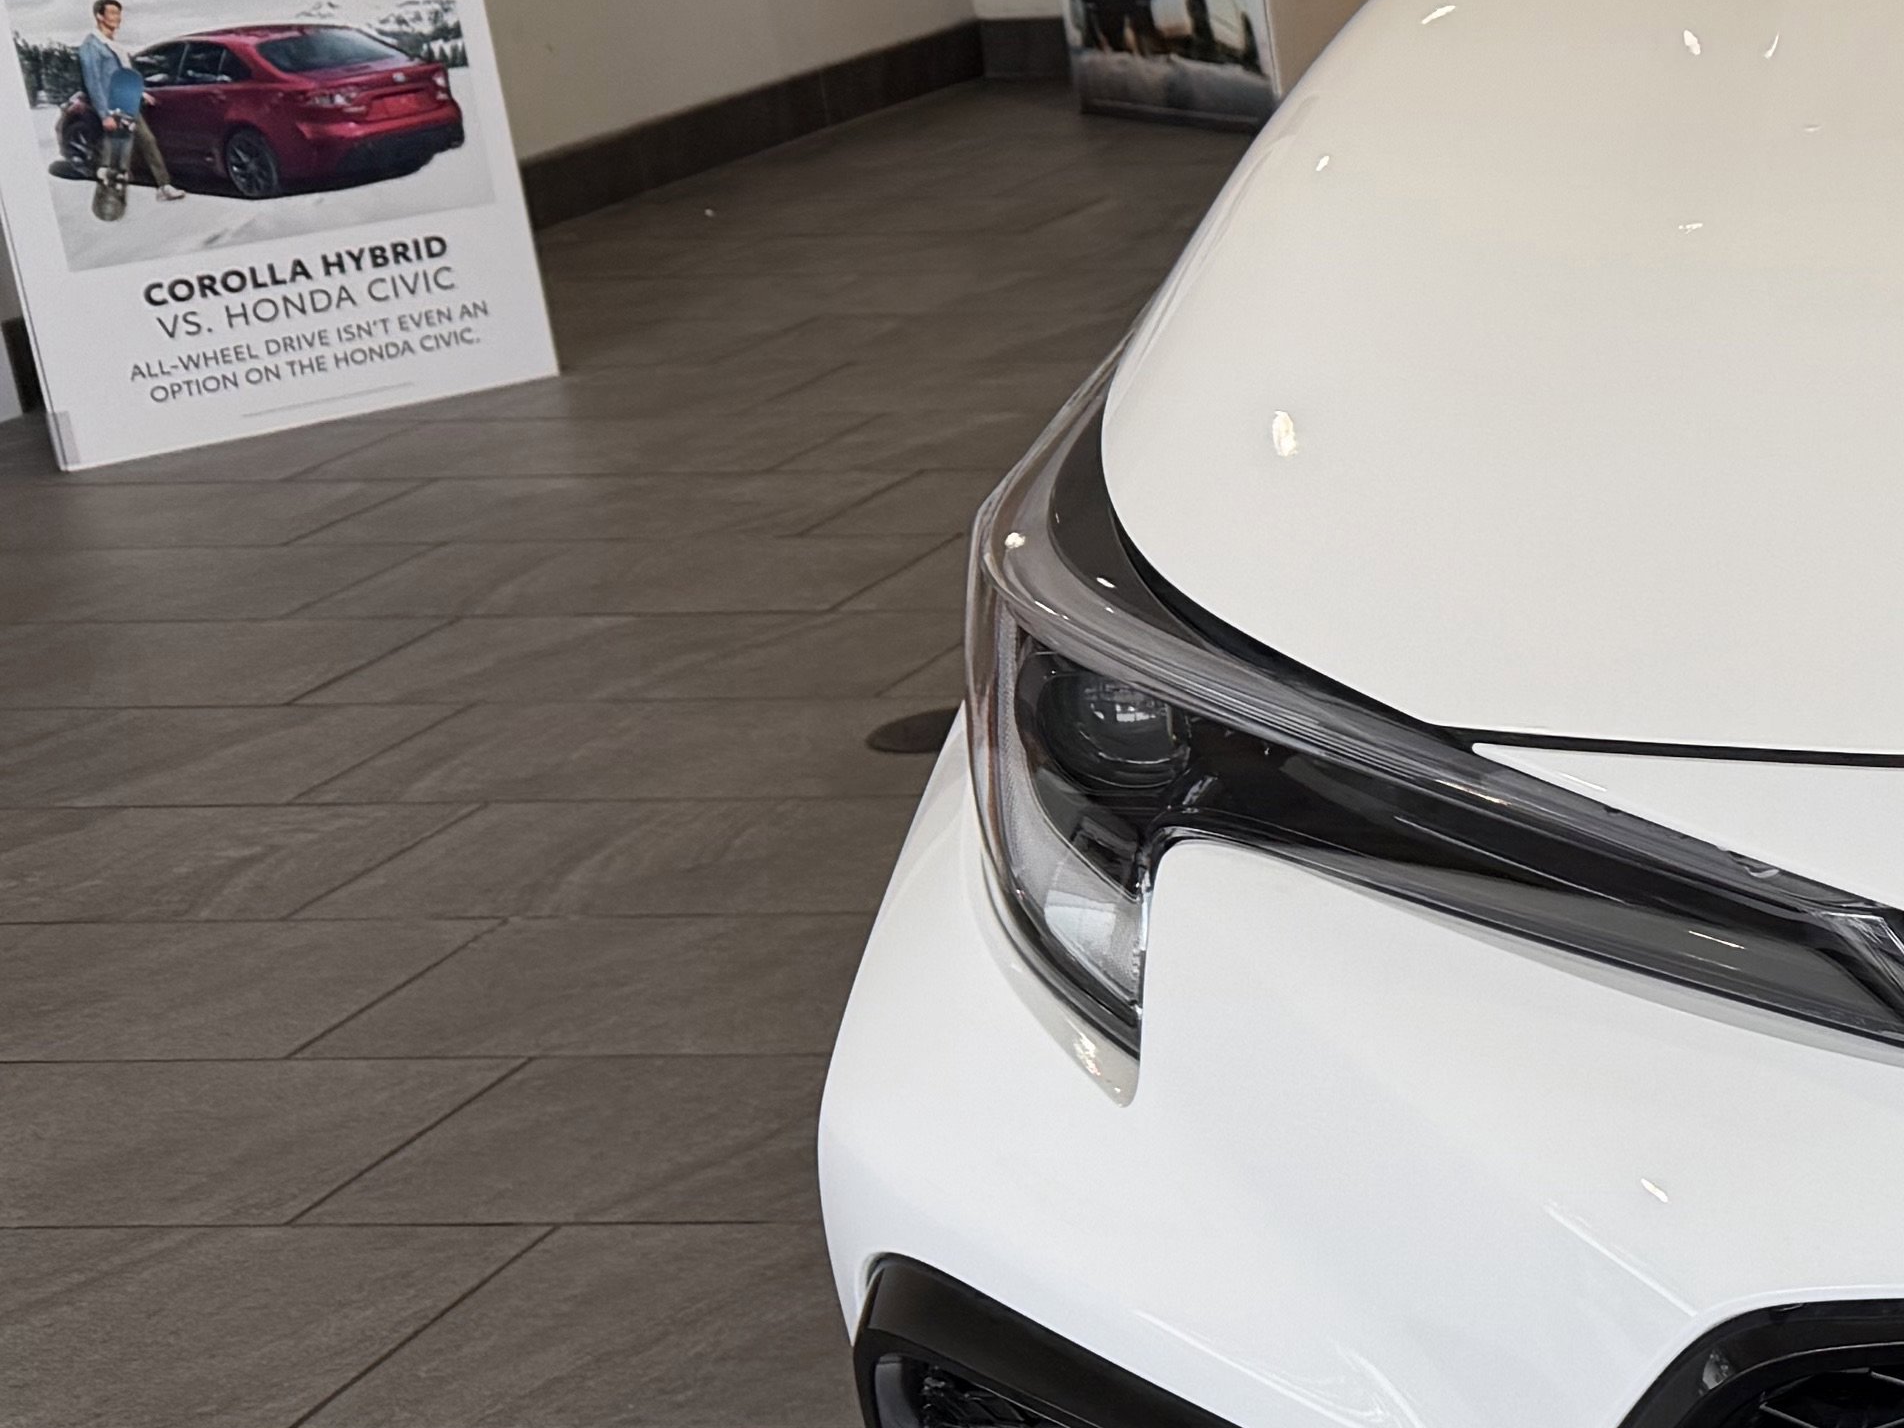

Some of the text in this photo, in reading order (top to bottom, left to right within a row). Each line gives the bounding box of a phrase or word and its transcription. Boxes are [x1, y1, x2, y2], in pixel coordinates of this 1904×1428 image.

[143, 235, 447, 307] COROLLA HYBRID
[156, 265, 456, 338] VS. HONDA CIVIC
[129, 300, 490, 382] ALL-WHEEL DRIVE ISN'T EVEN AN
[150, 327, 481, 403] OPTION ON THE HONDA CIVIC.
